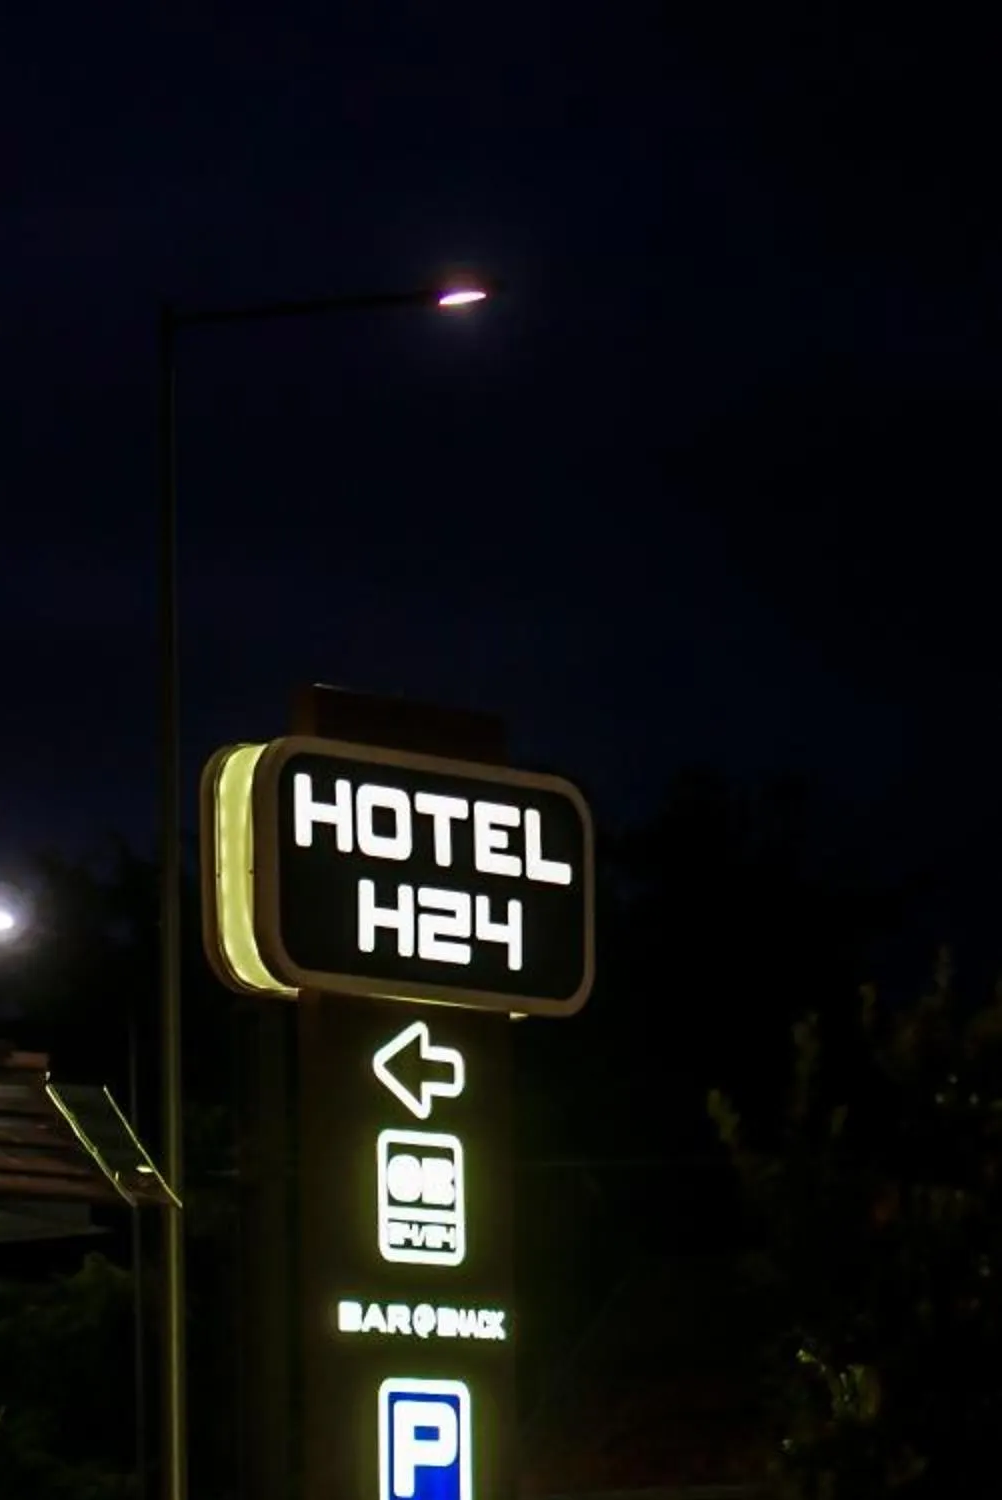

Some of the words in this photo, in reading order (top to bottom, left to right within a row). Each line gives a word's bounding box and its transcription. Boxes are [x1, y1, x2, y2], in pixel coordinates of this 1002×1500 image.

[294, 773, 572, 885] HOTEL
[358, 878, 523, 971] H24
[393, 1400, 458, 1498] P
